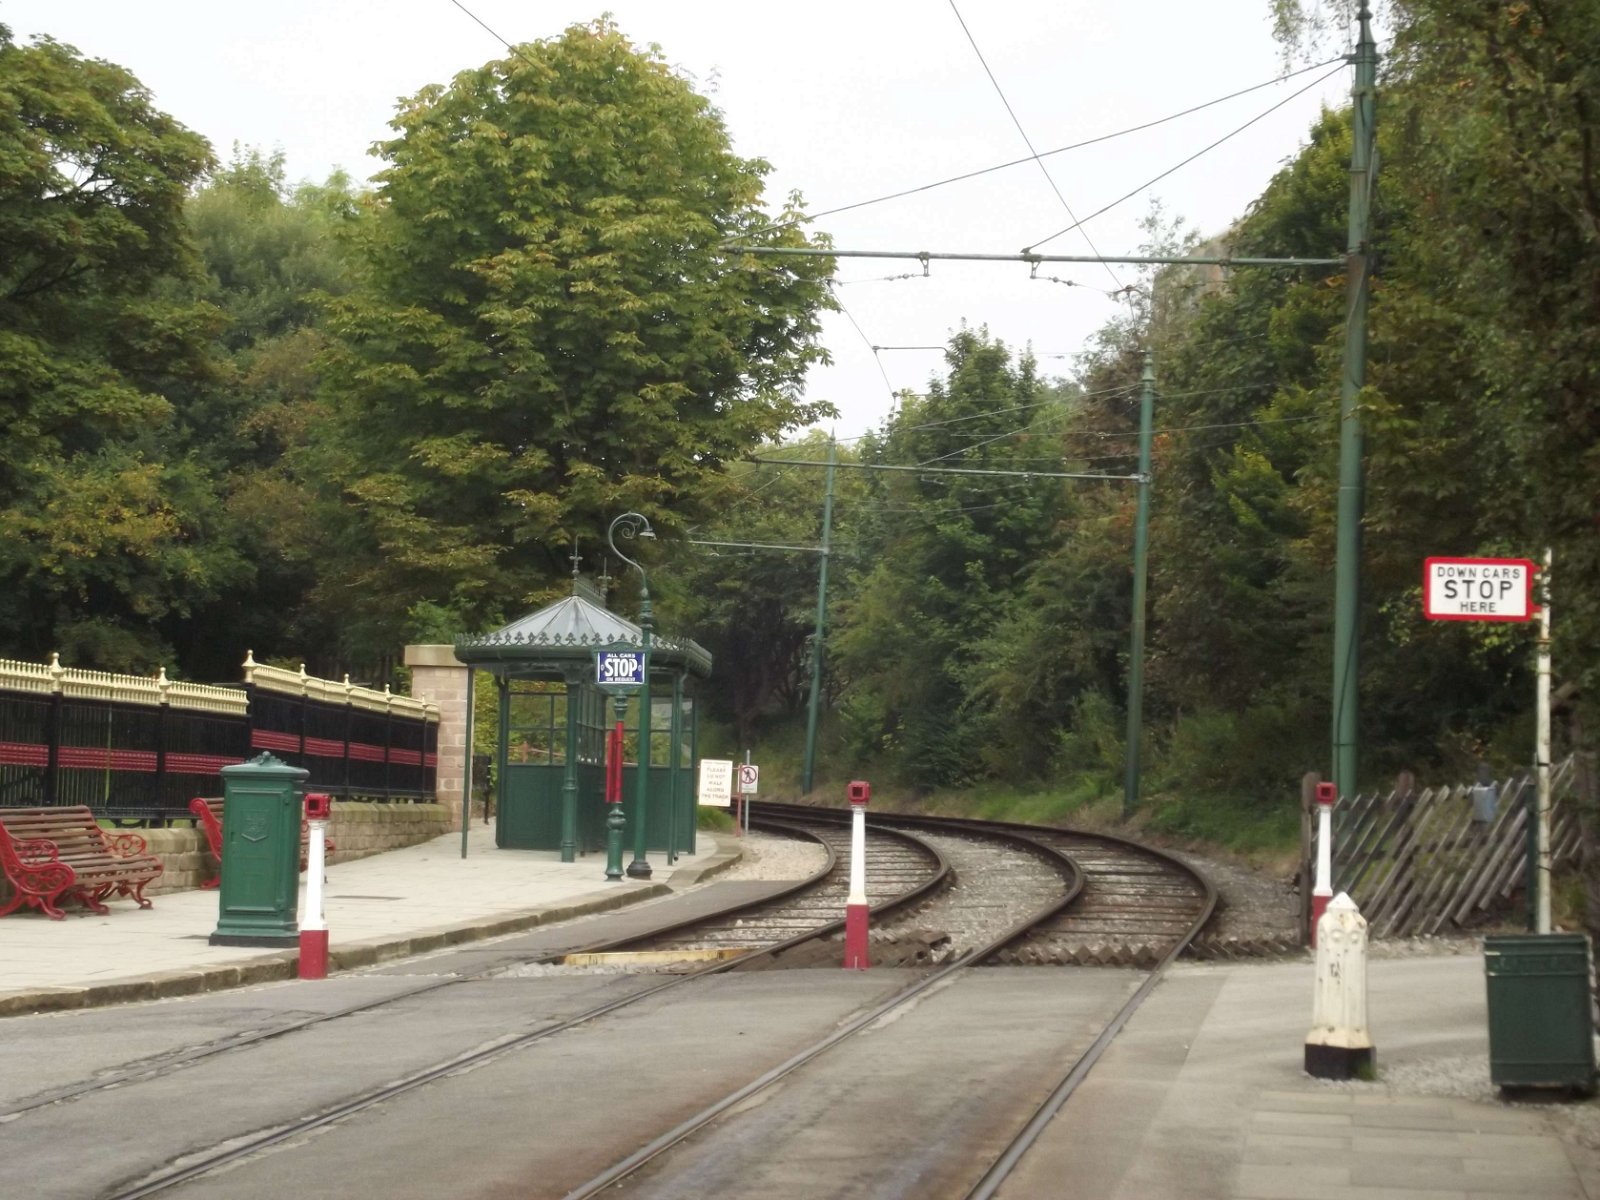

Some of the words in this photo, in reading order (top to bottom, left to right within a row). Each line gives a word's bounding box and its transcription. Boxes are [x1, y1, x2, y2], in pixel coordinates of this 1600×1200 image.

[1437, 566, 1477, 578] DOWN
[1482, 568, 1520, 579] CARS
[1444, 579, 1513, 600] STOP
[1460, 602, 1496, 613] HERE
[604, 658, 638, 677] STOP
